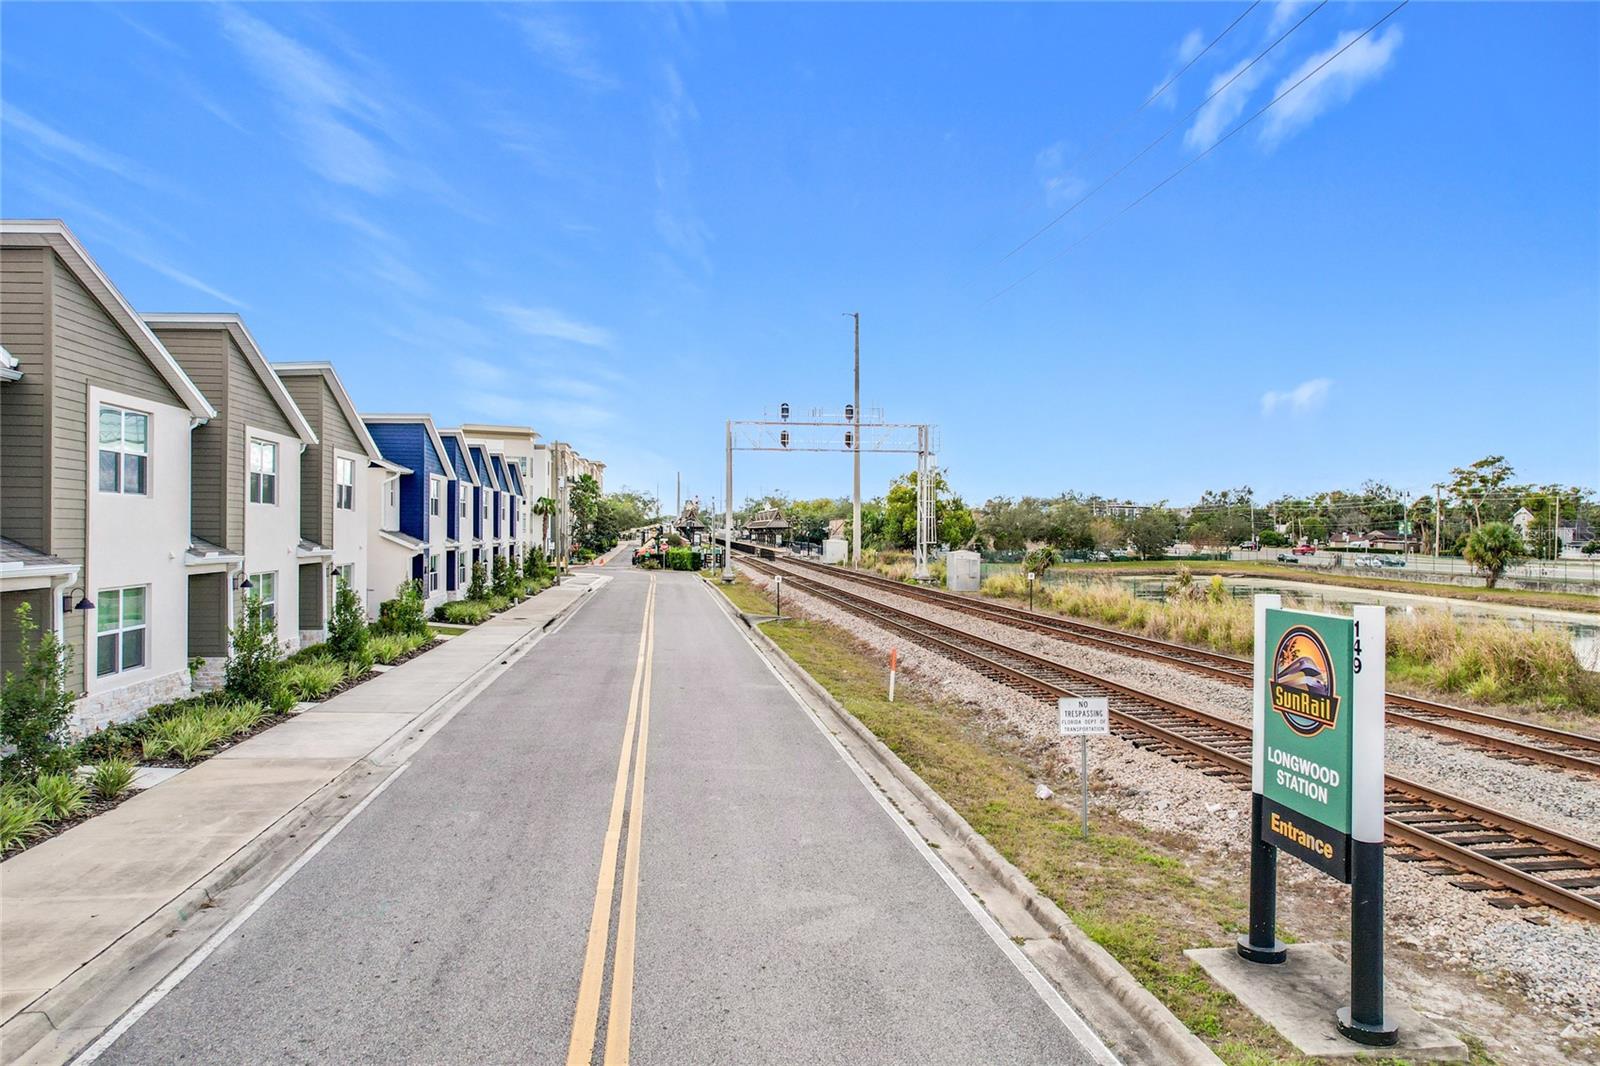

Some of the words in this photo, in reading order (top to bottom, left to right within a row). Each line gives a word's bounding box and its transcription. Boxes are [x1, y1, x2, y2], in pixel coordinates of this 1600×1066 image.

[1354, 620, 1362, 674] 149
[1064, 710, 1103, 718] TRESPASSING
[1275, 686, 1331, 720] SunRail
[1267, 746, 1340, 787] LONGWOOD
[1276, 769, 1328, 804] STATION
[1271, 812, 1334, 859] Entrance
